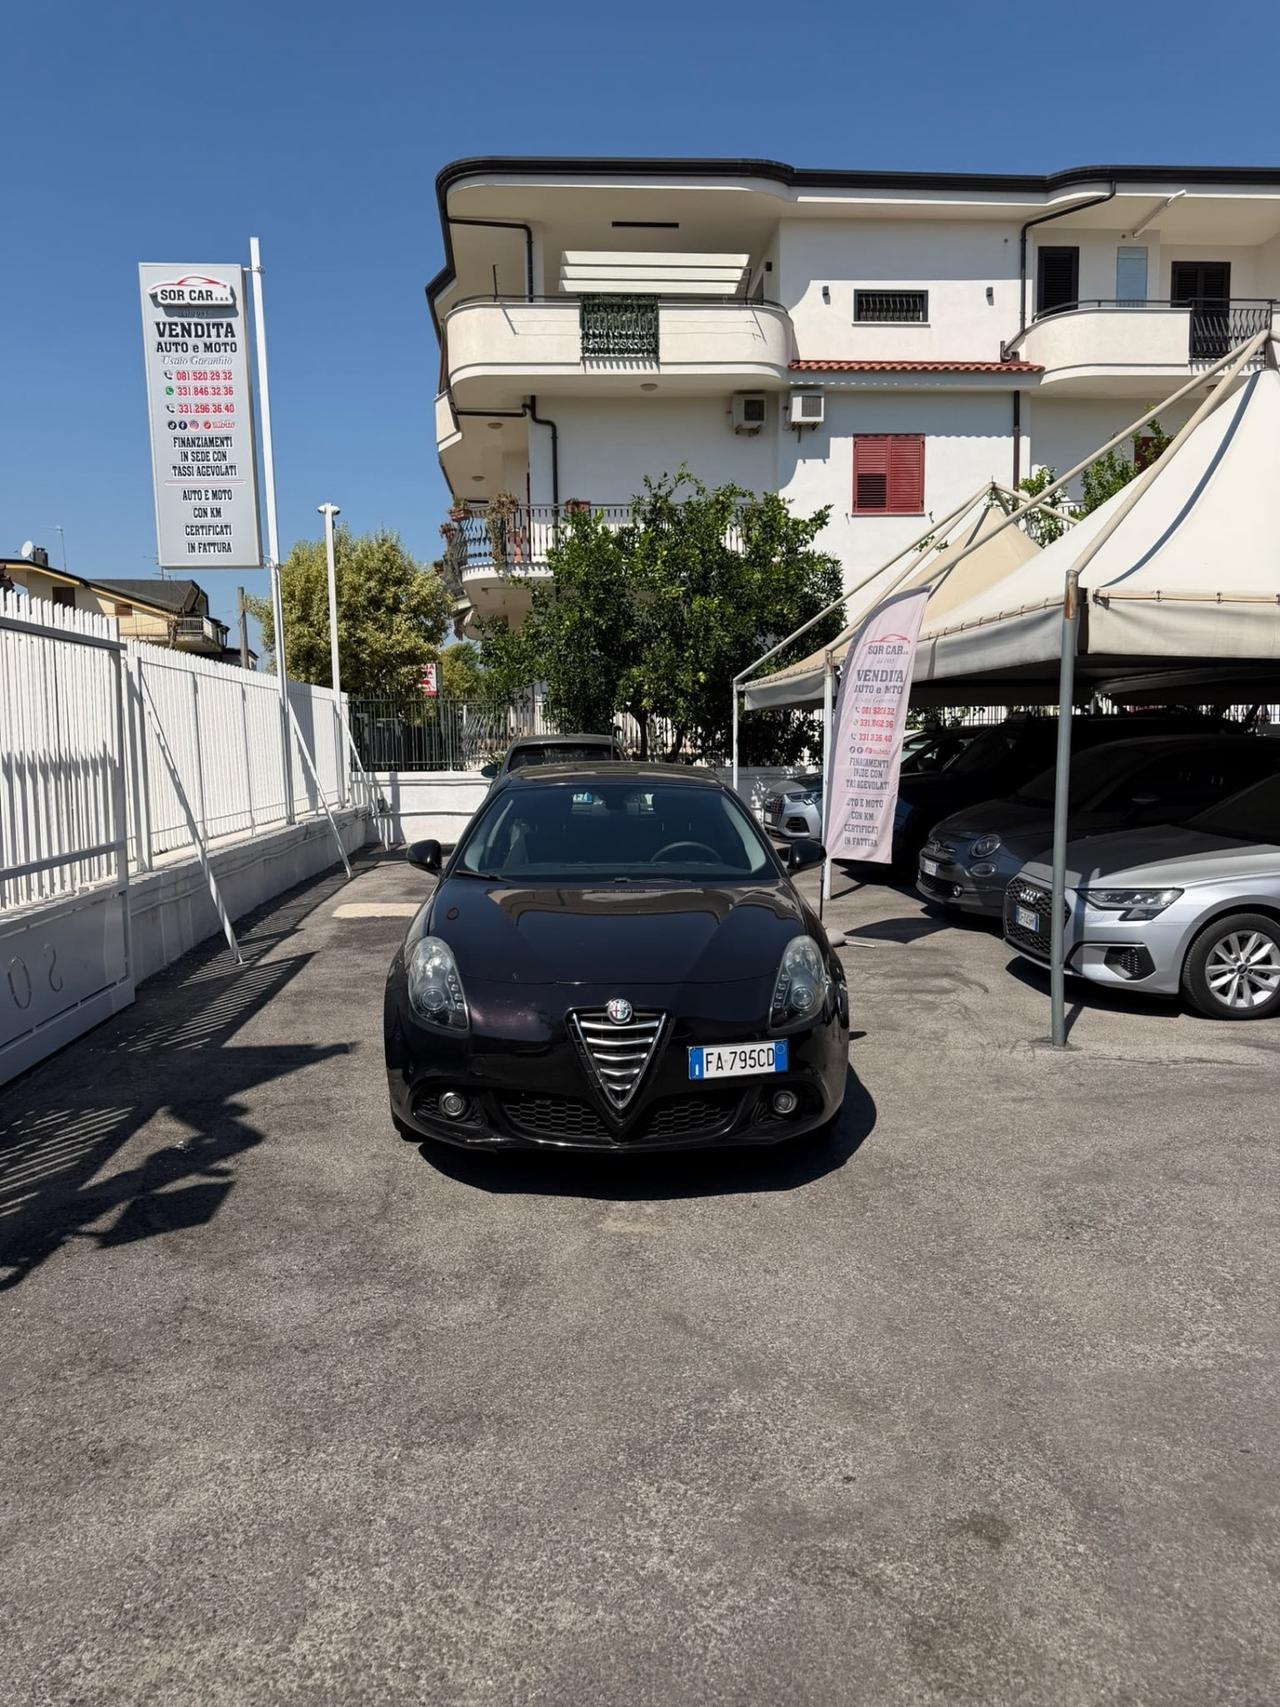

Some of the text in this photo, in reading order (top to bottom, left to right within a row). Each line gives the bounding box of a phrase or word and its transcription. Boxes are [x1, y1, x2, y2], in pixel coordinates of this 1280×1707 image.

[160, 290, 185, 301] SOR
[155, 322, 236, 338] VENDITA
[156, 342, 237, 353] AUTO e MOTO
[162, 356, 232, 366] Usato Garantito
[173, 436, 233, 448] FINANZIAMENTI
[180, 451, 227, 462] IN SEDE CON
[172, 465, 237, 477] TASSI AGEVOLATI
[182, 490, 233, 501] AUTO E MOTO
[193, 507, 222, 518] CON KM
[185, 525, 232, 536] CERTIFICATI
[187, 542, 232, 553] IN FATTURA
[868, 645, 884, 655] SOR
[857, 669, 904, 682] VENDIA
[865, 799, 883, 808] MOTO
